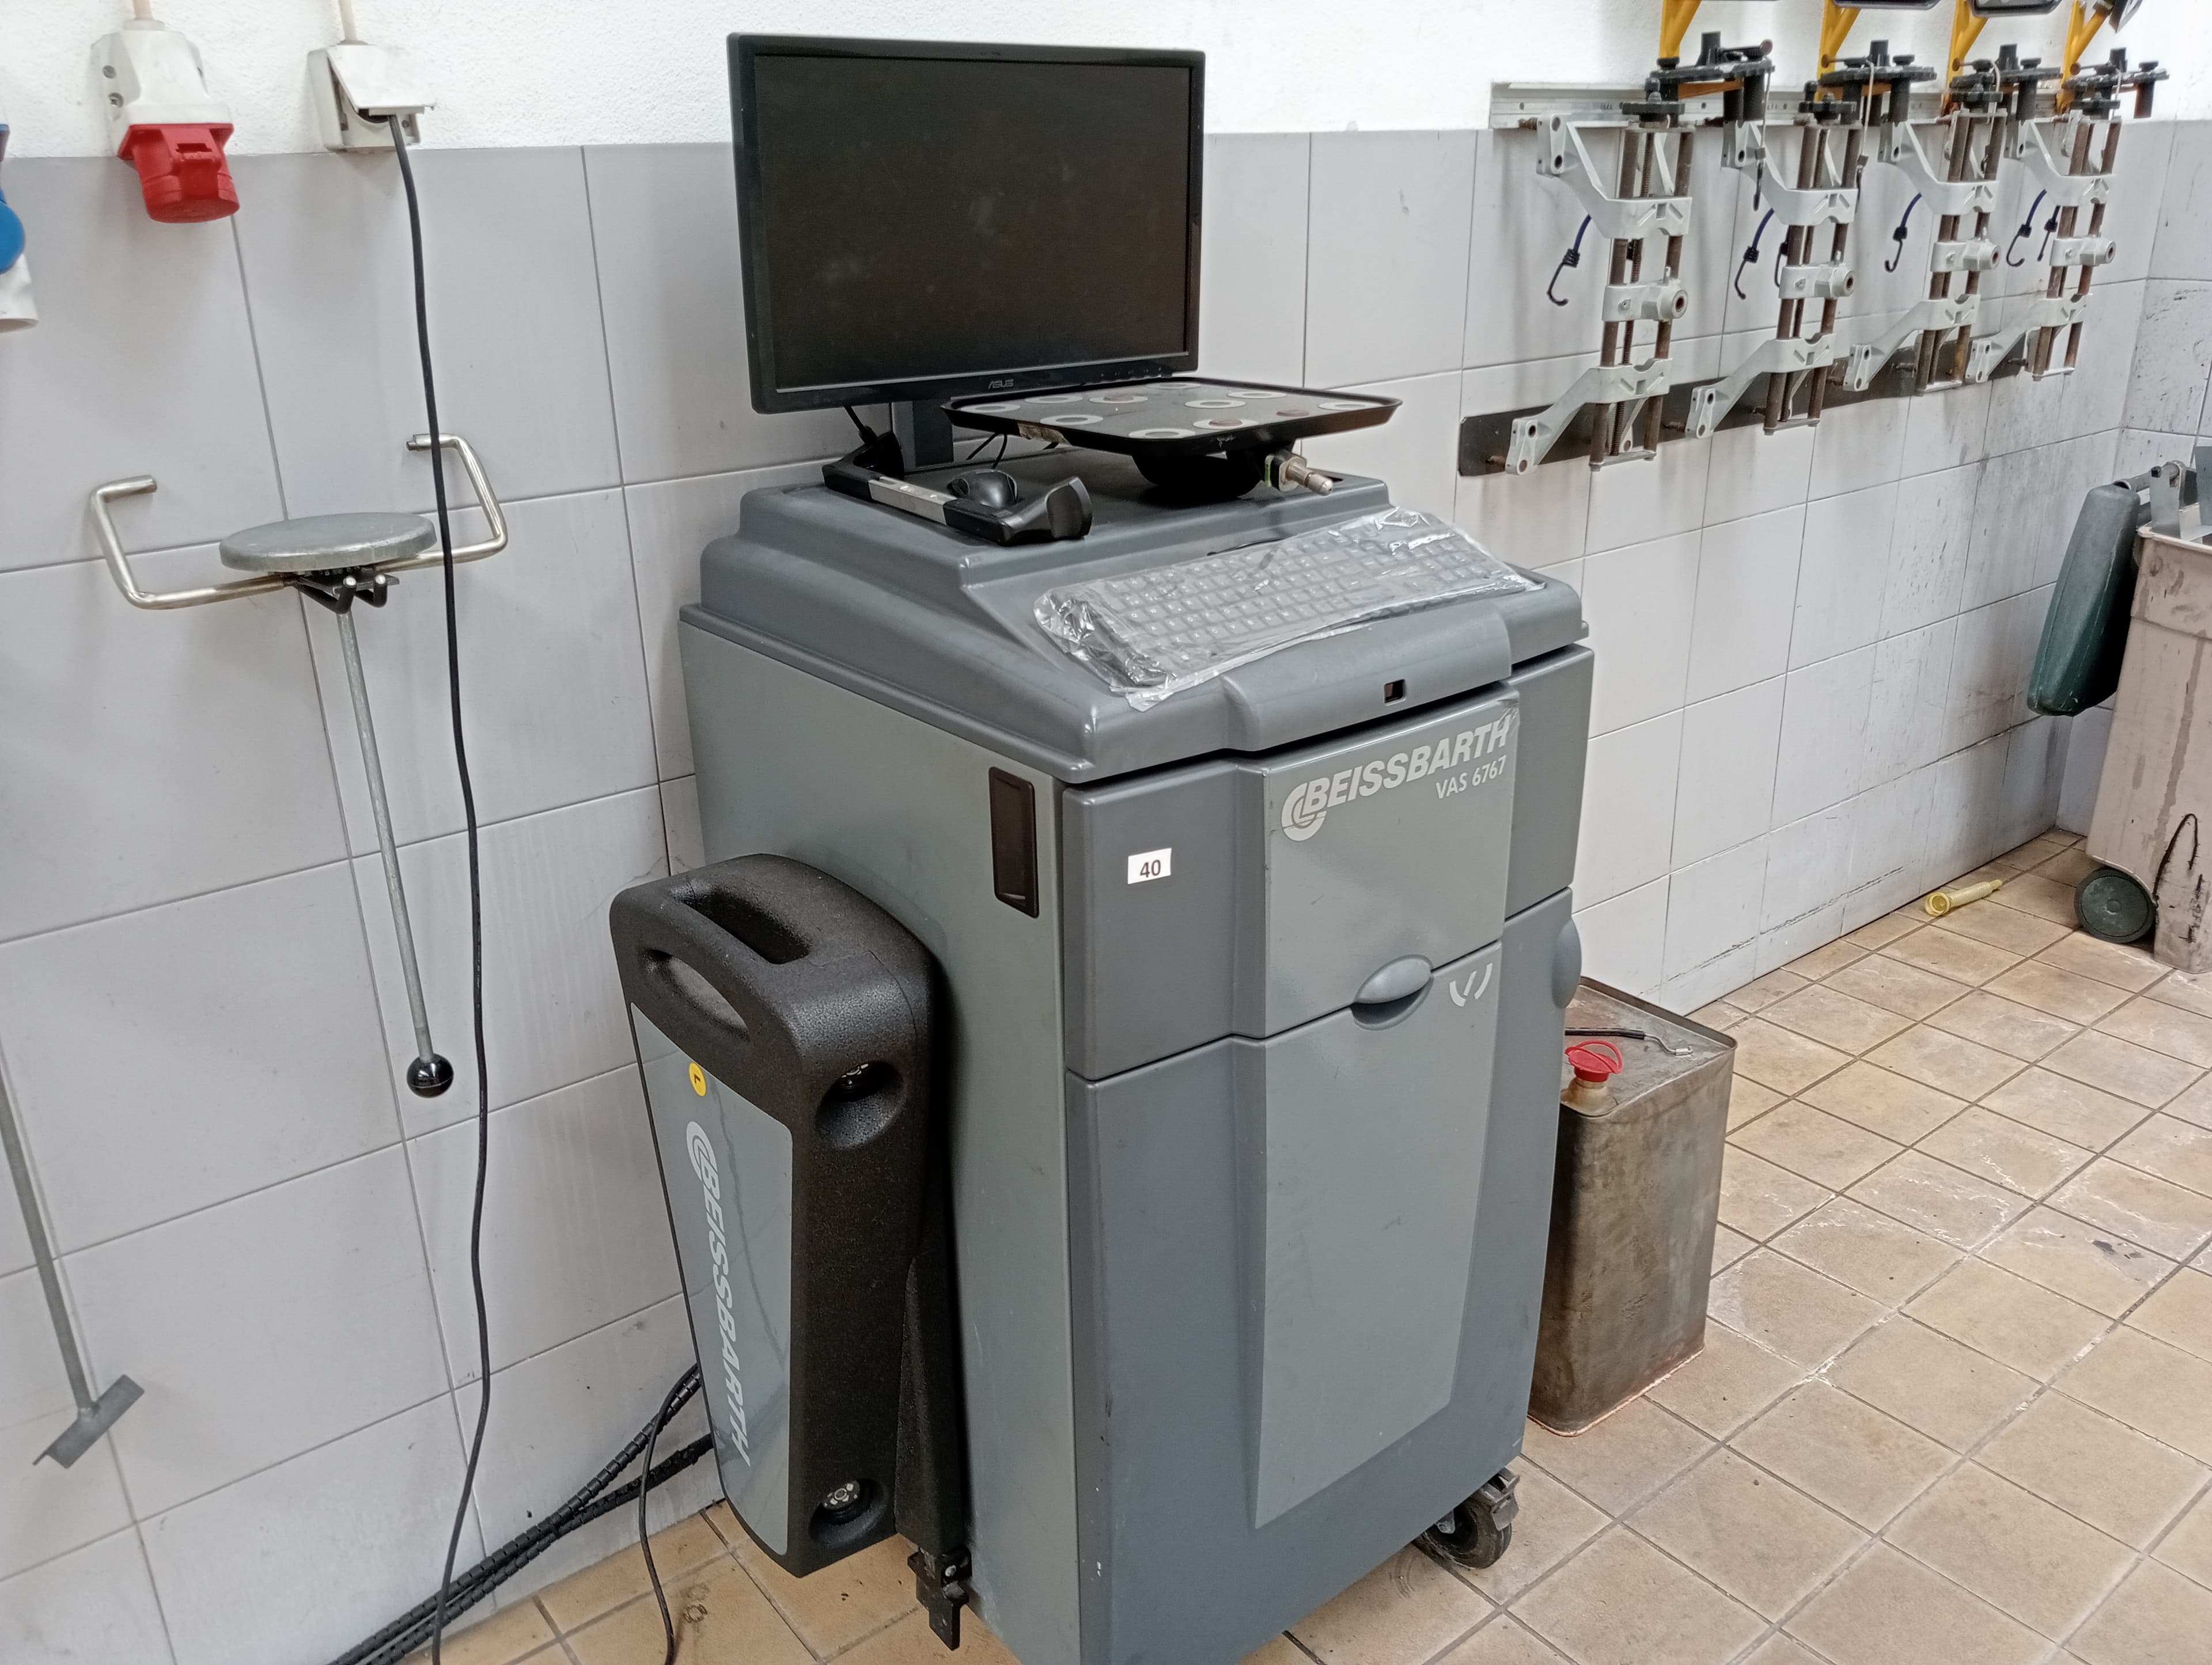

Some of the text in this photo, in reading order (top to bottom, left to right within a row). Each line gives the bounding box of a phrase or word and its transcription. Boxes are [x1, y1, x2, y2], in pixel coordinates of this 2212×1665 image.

[988, 379, 1014, 389] ASUS
[1300, 714, 1512, 817] BEISSBARTH
[1435, 754, 1507, 799] VAS 6767
[1140, 859, 1161, 878] 40
[698, 1146, 751, 1467] BEISSBARTH
